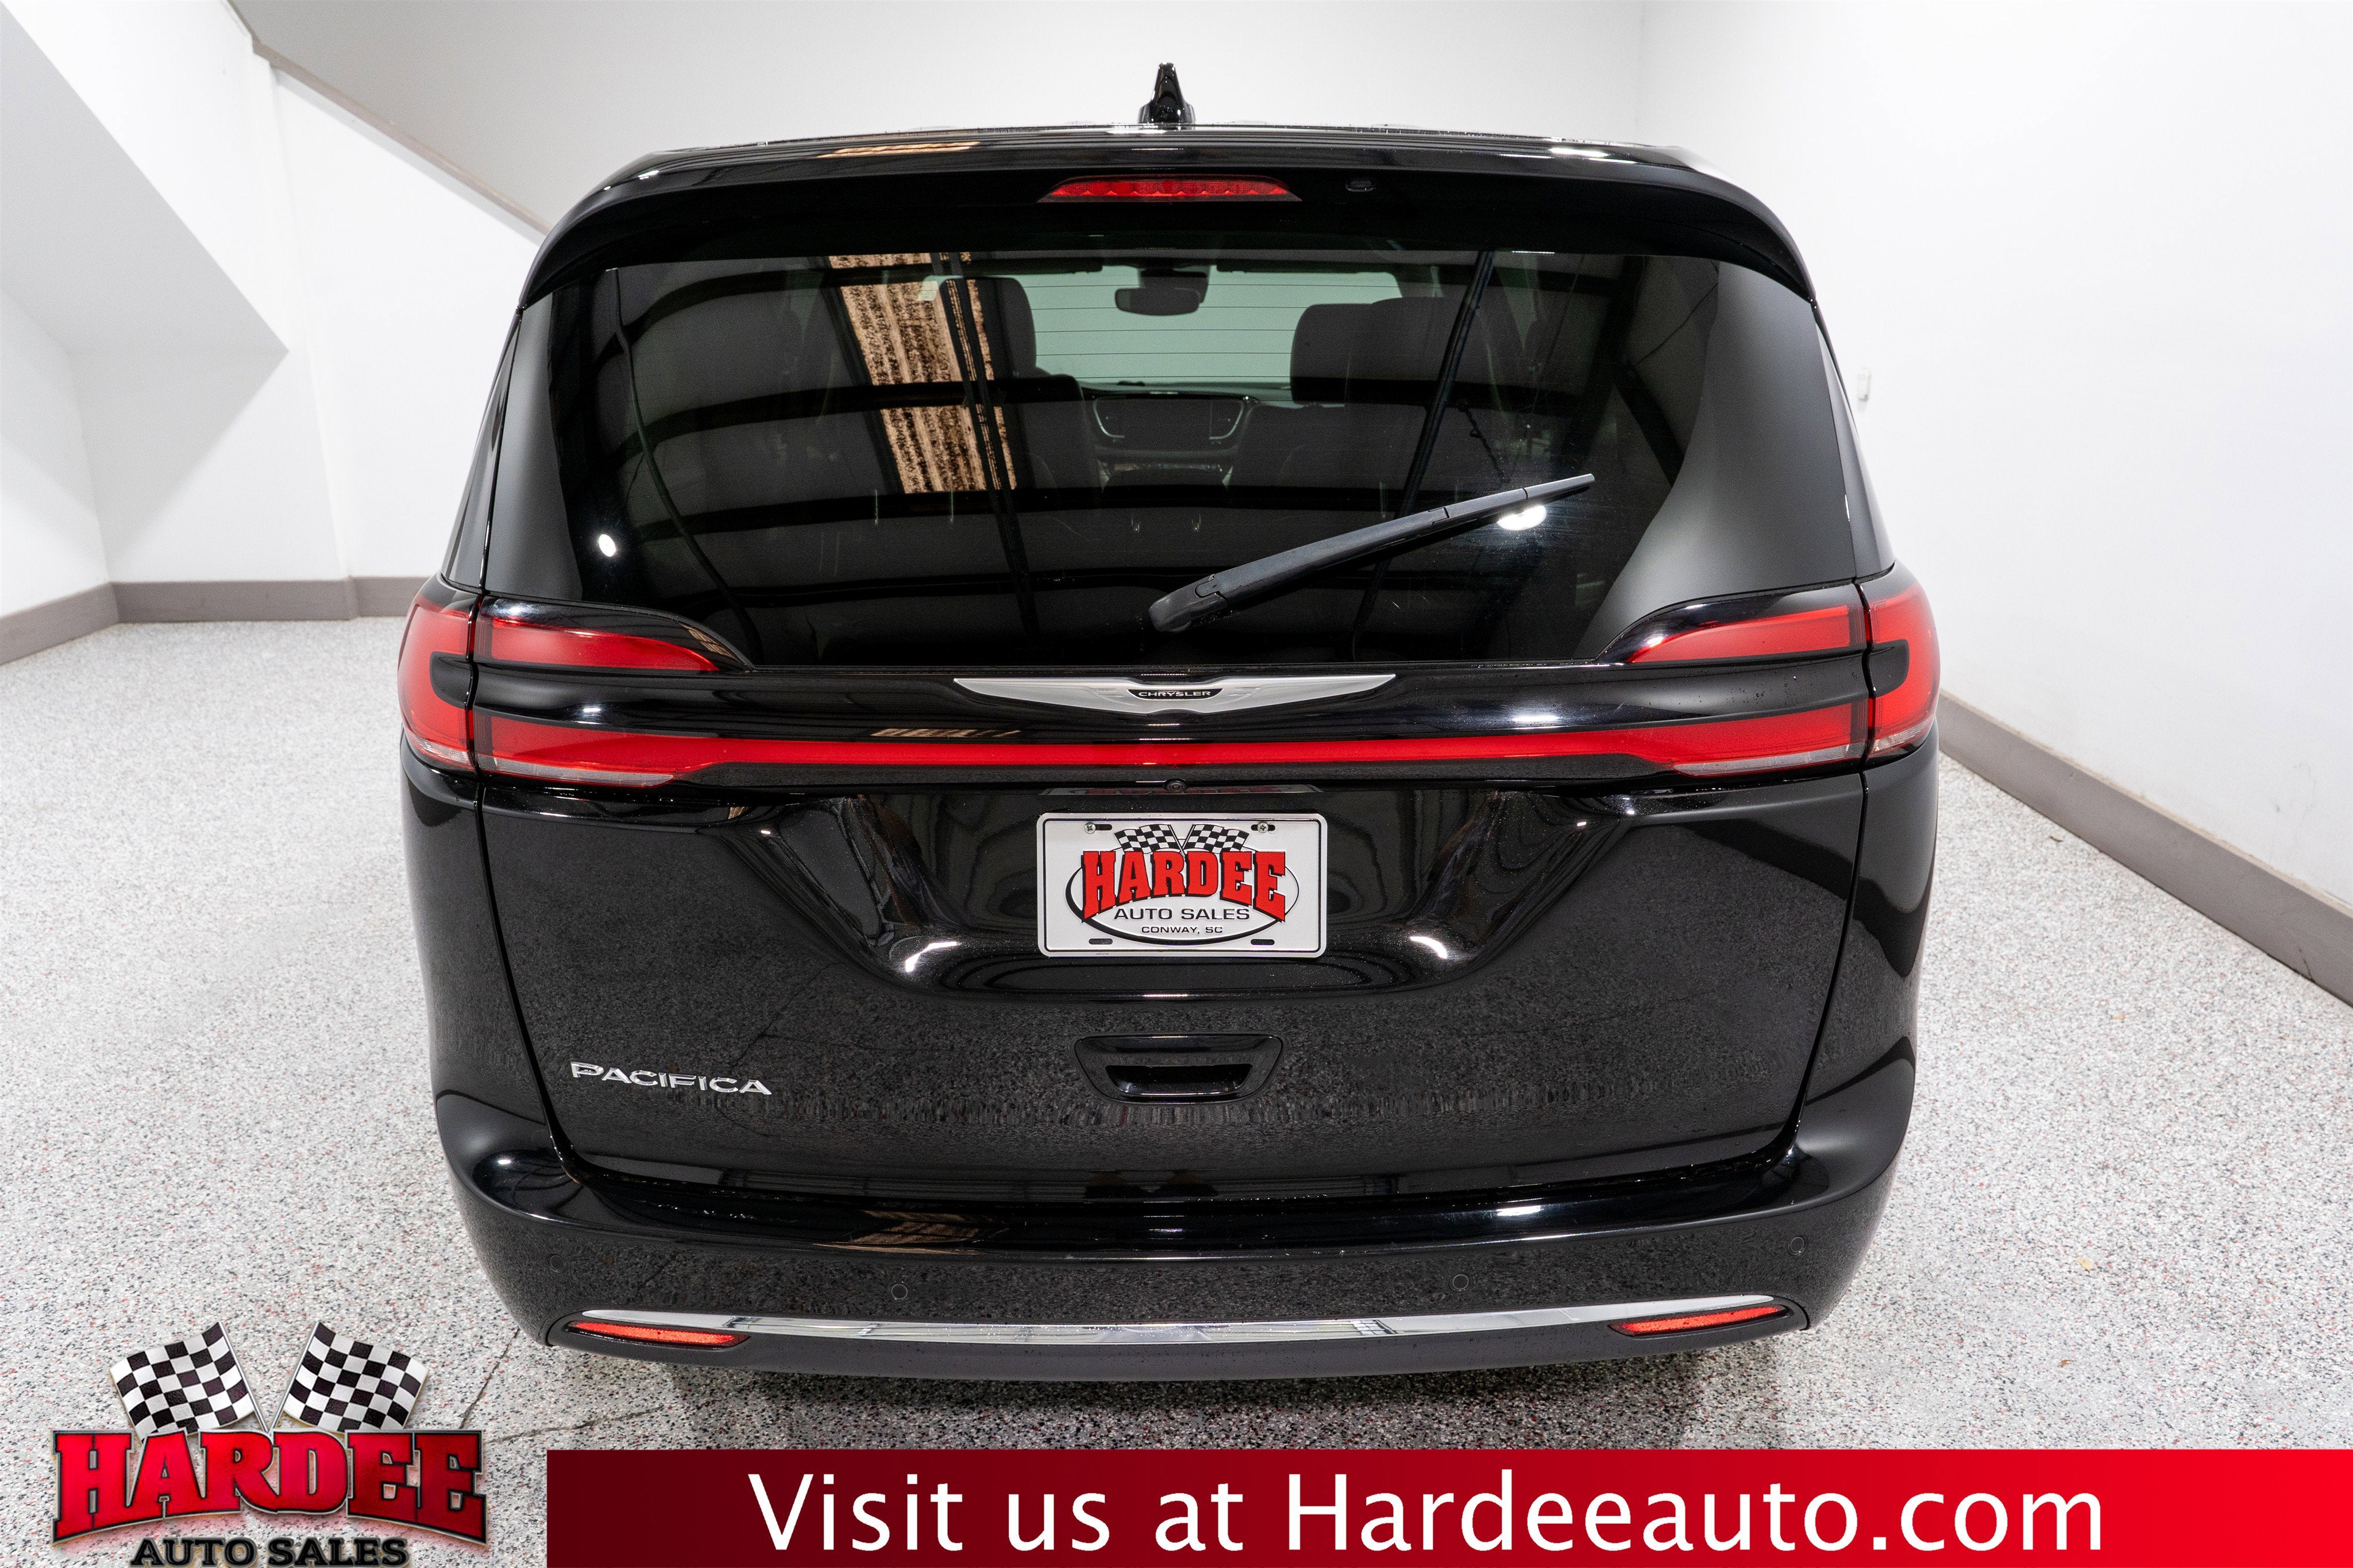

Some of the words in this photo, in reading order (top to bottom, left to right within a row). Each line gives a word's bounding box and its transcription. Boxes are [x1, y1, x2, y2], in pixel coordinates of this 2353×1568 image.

[1081, 851, 1286, 923] HARDEE
[1113, 908, 1173, 920] AUTO
[1181, 908, 1250, 920] SALES
[1141, 926, 1201, 934] CONWAY,
[1205, 926, 1224, 934] SC
[570, 1061, 772, 1095] PACIFICA
